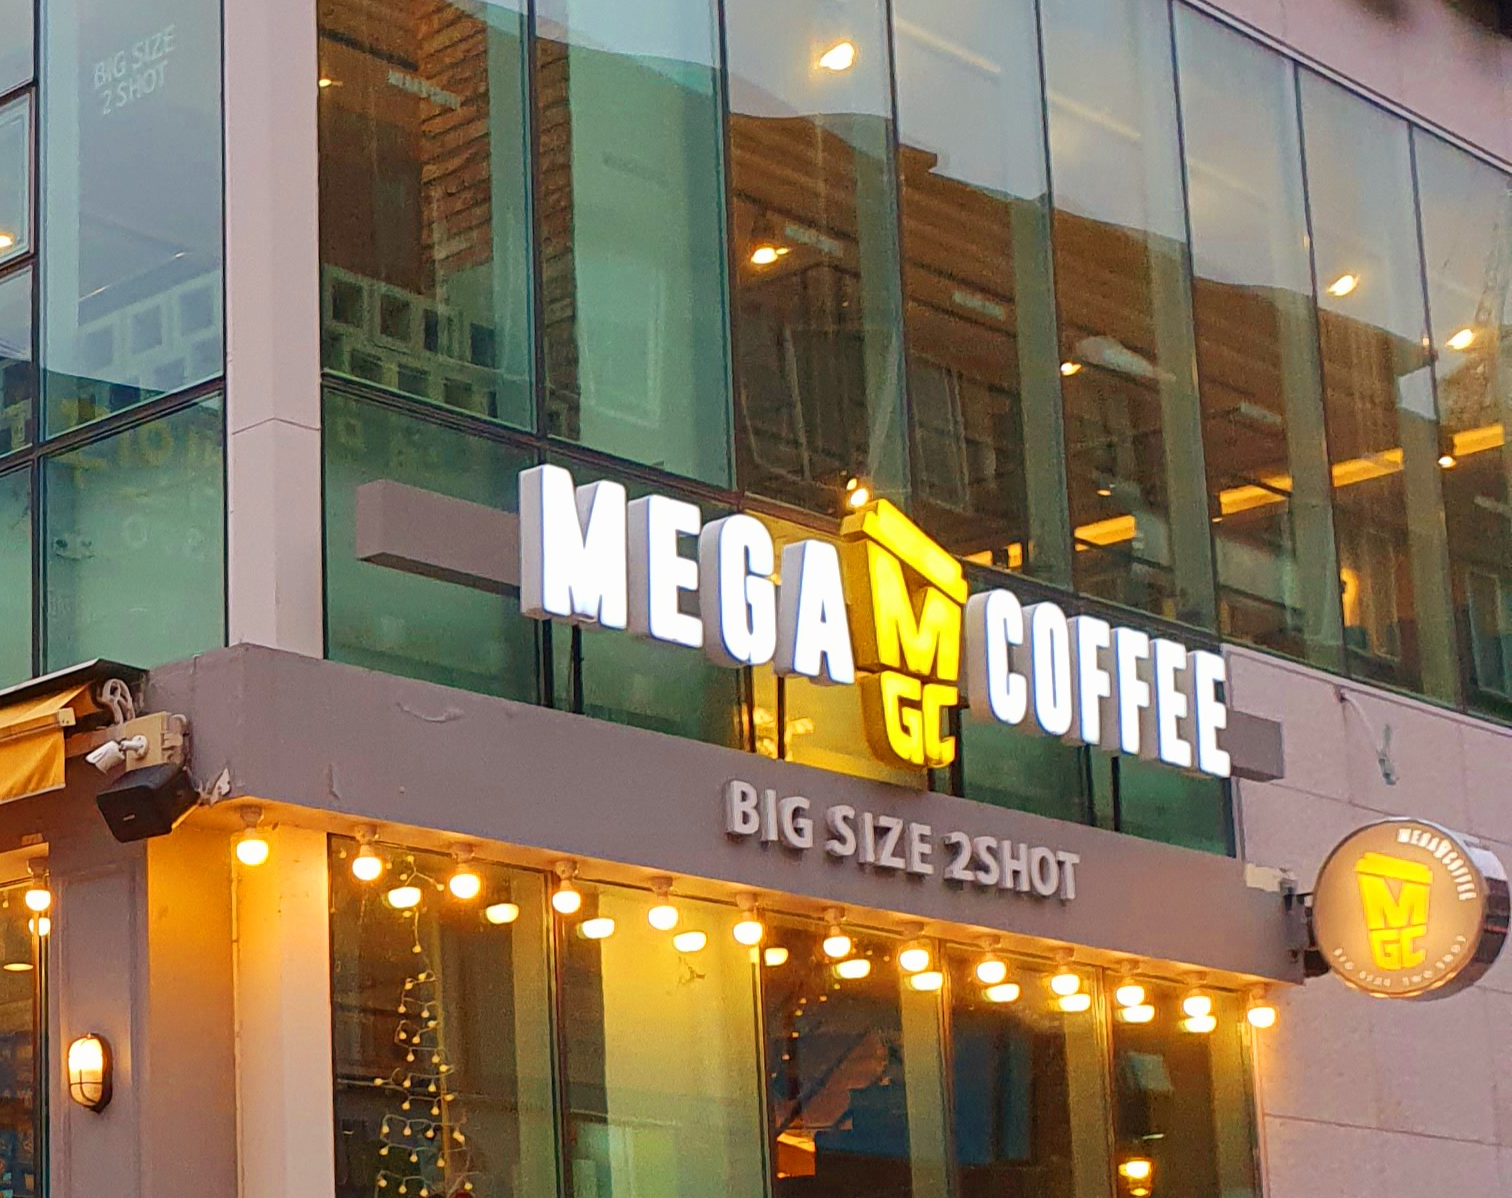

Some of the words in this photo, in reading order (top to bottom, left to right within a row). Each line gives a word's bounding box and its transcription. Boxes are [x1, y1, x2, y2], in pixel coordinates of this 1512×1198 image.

[94, 50, 127, 90] BIG
[131, 24, 176, 69] SIZE
[533, 464, 855, 685] MEGA
[982, 588, 1232, 778] COFFEE
[728, 779, 815, 849] BIG
[826, 803, 934, 876] SIZE
[944, 830, 1081, 901] 2SHOT
